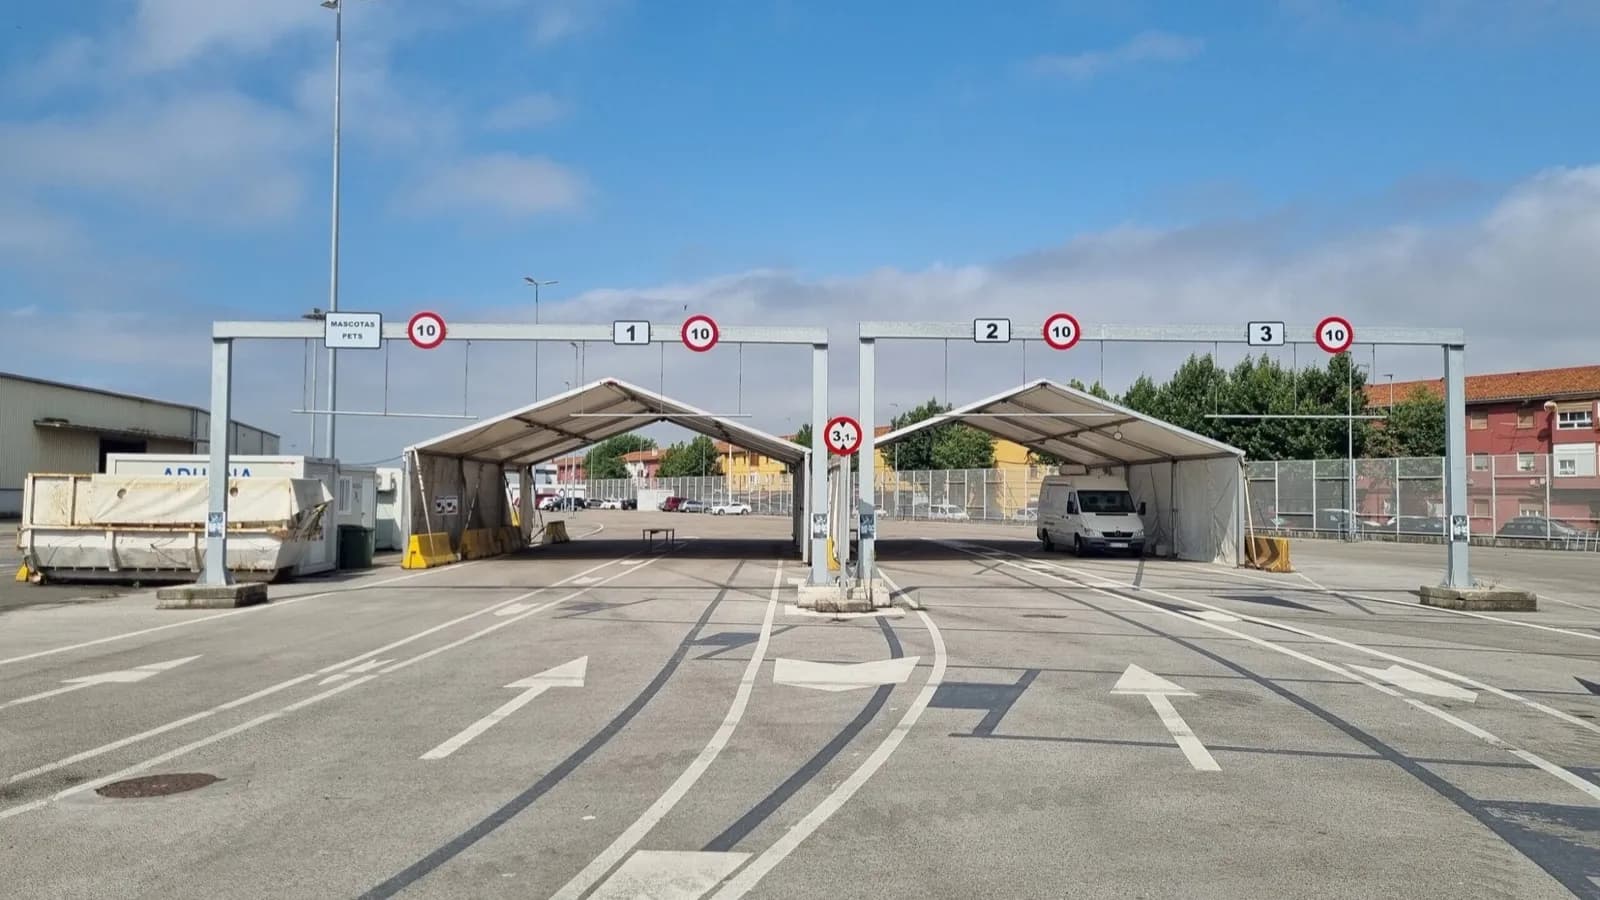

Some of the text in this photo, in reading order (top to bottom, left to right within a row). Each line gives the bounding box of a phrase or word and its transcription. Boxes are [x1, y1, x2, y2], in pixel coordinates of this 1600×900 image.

[416, 324, 436, 336] 10
[626, 325, 635, 341] 1
[691, 328, 710, 340] 10
[986, 323, 998, 339] 2
[1052, 326, 1071, 338] 10
[1260, 326, 1272, 342] 3
[1325, 330, 1344, 341] 10
